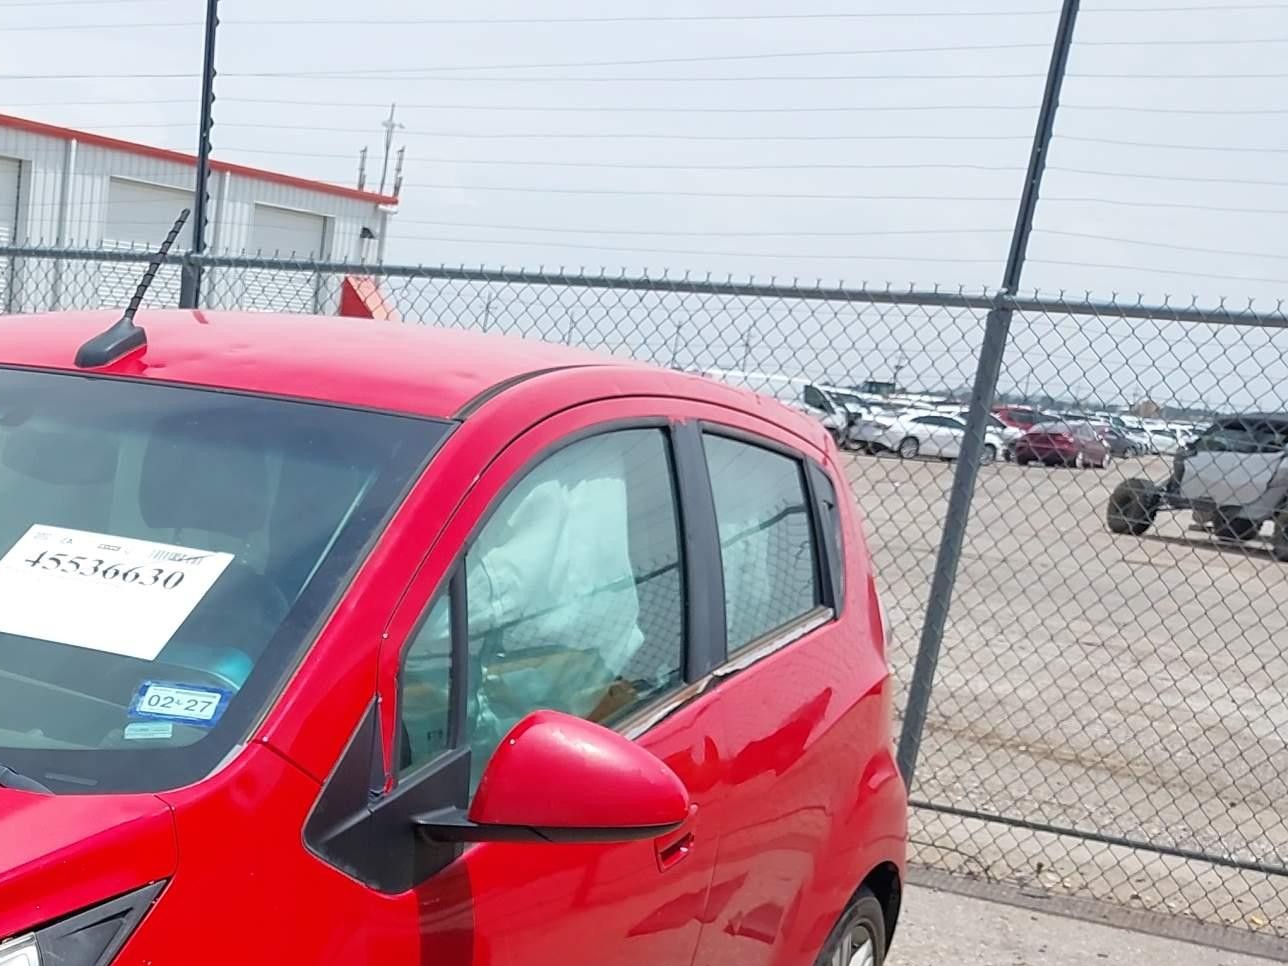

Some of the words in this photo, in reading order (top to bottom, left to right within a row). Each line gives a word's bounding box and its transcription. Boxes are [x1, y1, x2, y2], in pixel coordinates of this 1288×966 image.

[24, 551, 185, 590] 45536630
[147, 693, 174, 709] 02
[184, 698, 212, 713] 27
